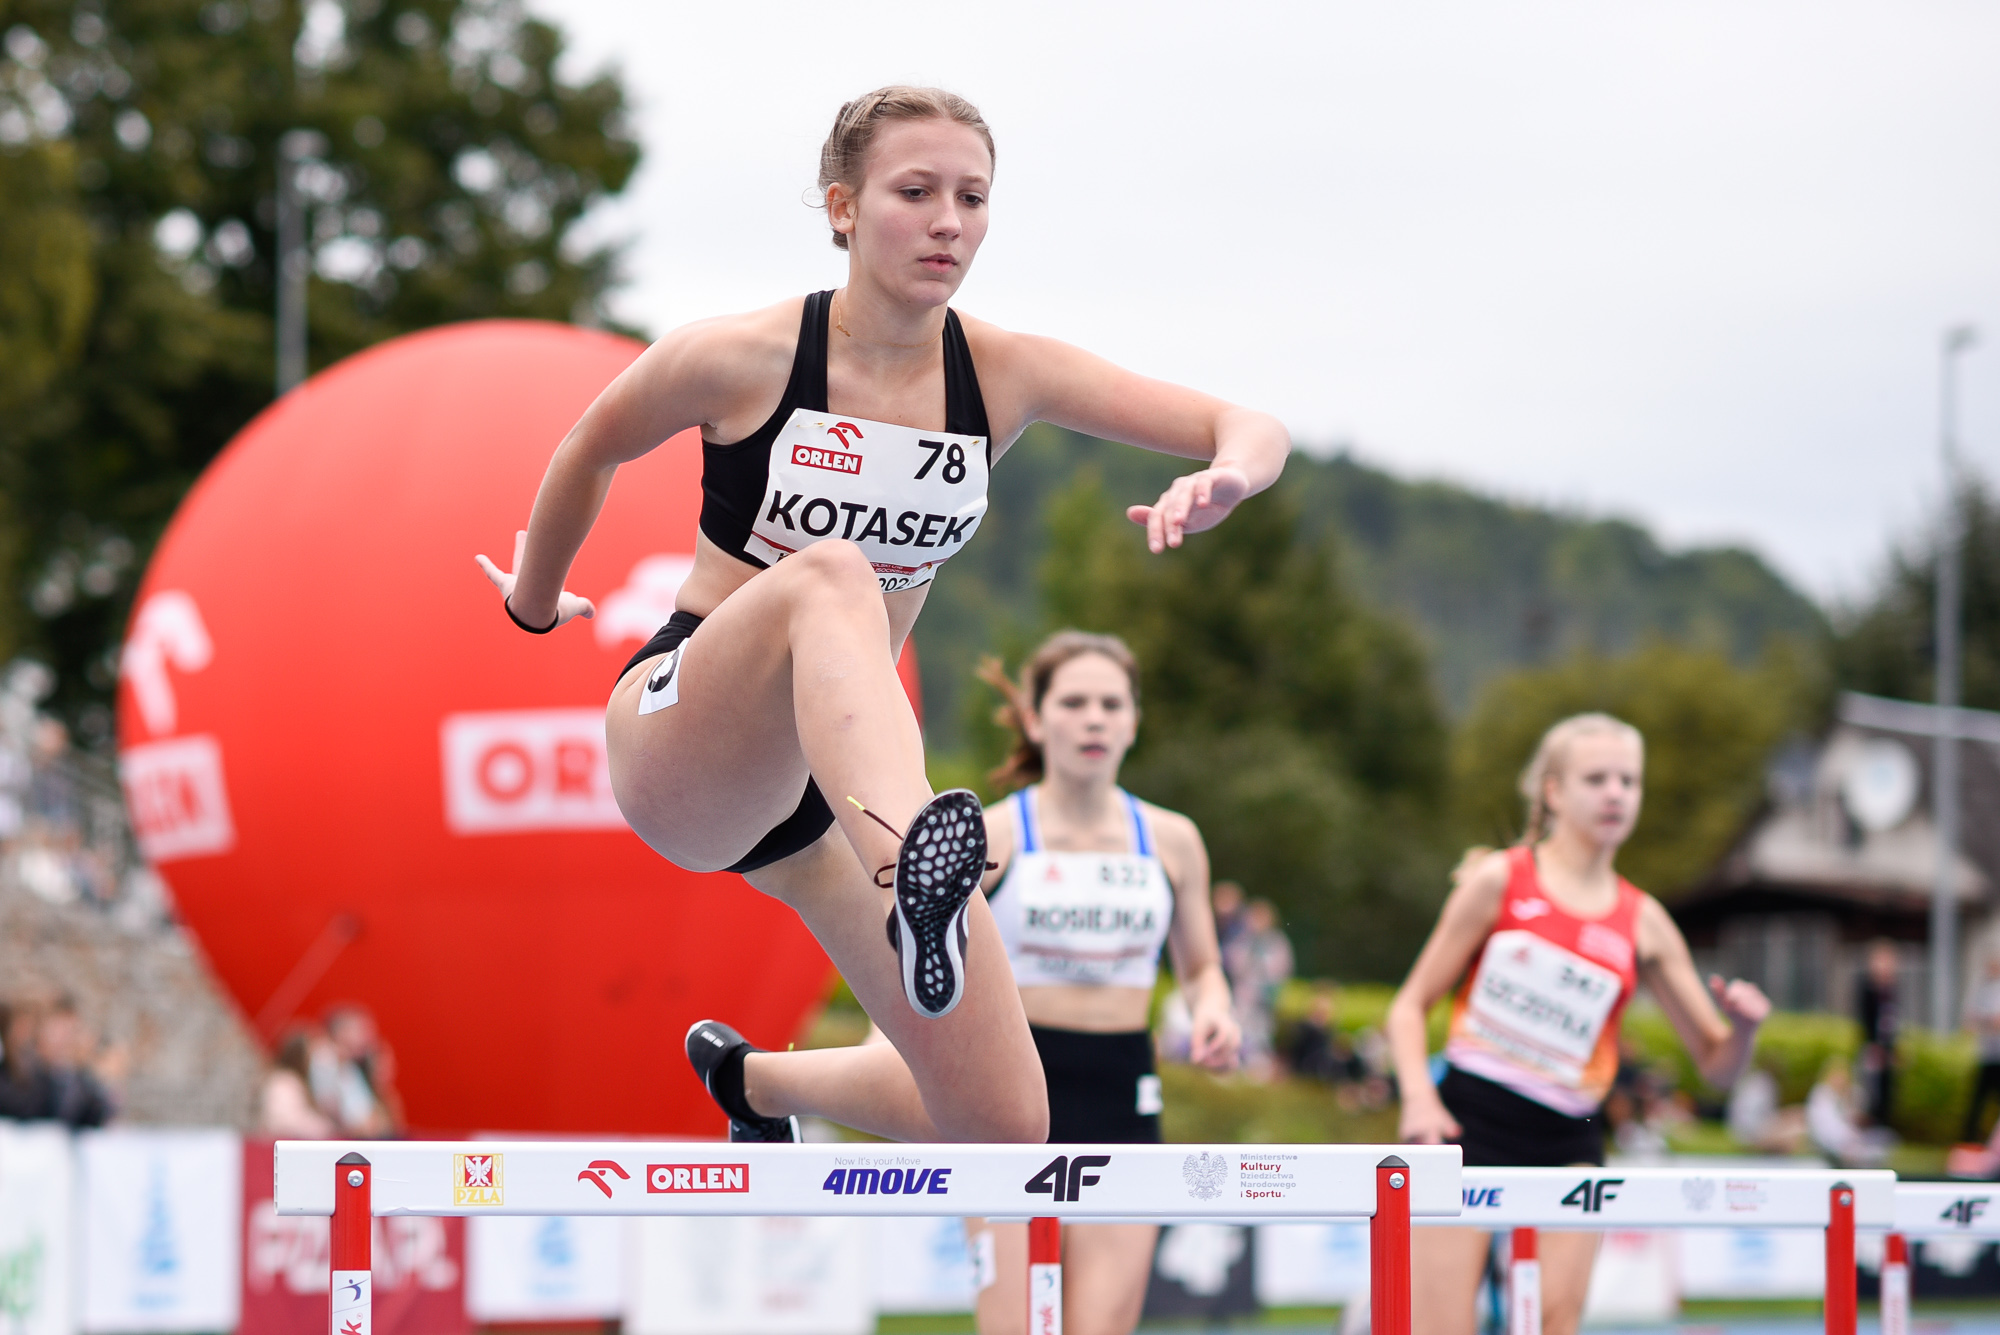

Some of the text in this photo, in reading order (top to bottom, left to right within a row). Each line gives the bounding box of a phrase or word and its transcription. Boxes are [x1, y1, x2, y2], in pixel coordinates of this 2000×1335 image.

[795, 448, 859, 472] ORLEN
[914, 439, 967, 484] 78
[766, 490, 976, 548] KOTASEK
[834, 1157, 921, 1167] Now It's your Move
[1240, 1162, 1281, 1173] Kultury
[651, 1167, 743, 1190] ORLEN
[823, 1168, 952, 1194] 4MOVE
[1024, 1155, 1111, 1202] 4F
[1240, 1181, 1297, 1189] Narodowego
[456, 1187, 501, 1203] PZLA
[1561, 1179, 1625, 1212] 4F
